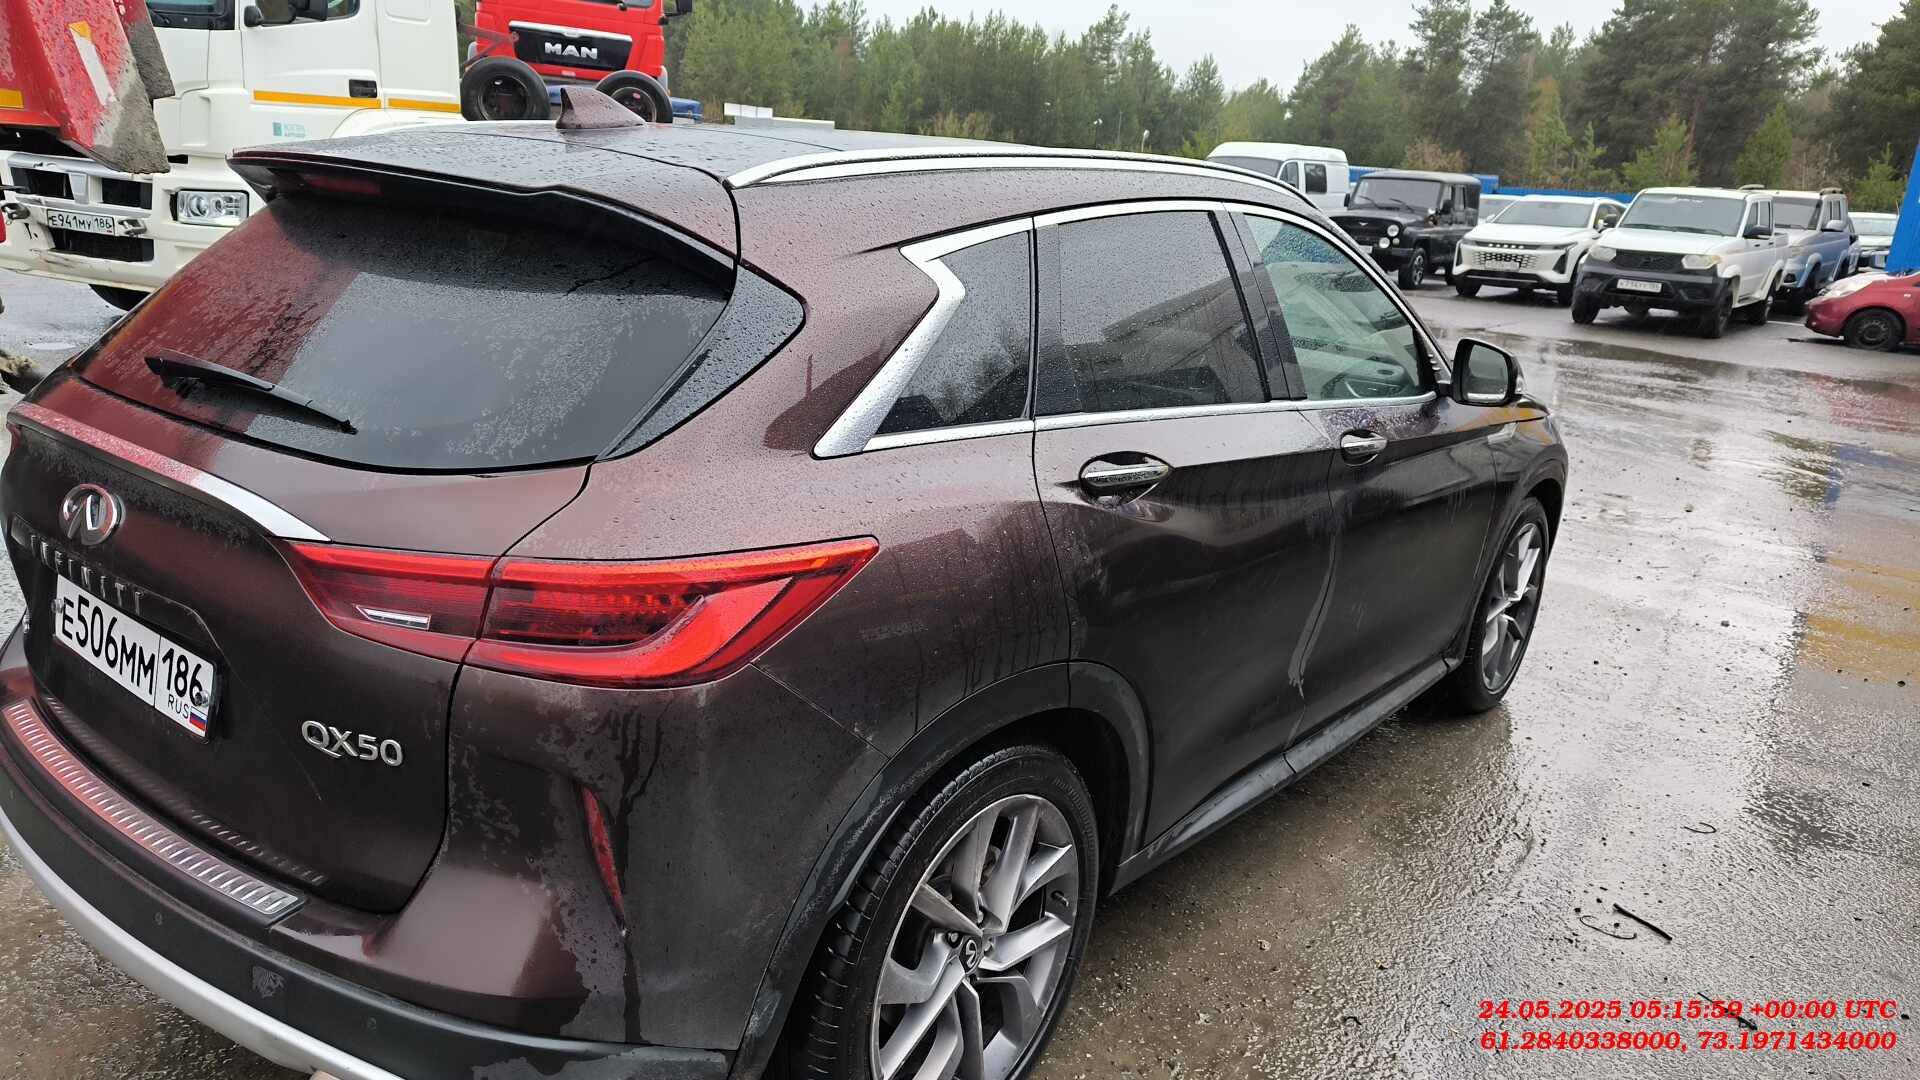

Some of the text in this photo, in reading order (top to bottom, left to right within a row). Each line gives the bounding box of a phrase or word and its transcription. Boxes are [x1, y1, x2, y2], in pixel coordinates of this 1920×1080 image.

[544, 42, 598, 60] MAN
[94, 217, 112, 229] 186
[61, 594, 204, 706] Е506ММ 186
[167, 693, 190, 720] RUS
[301, 720, 403, 767] QX50
